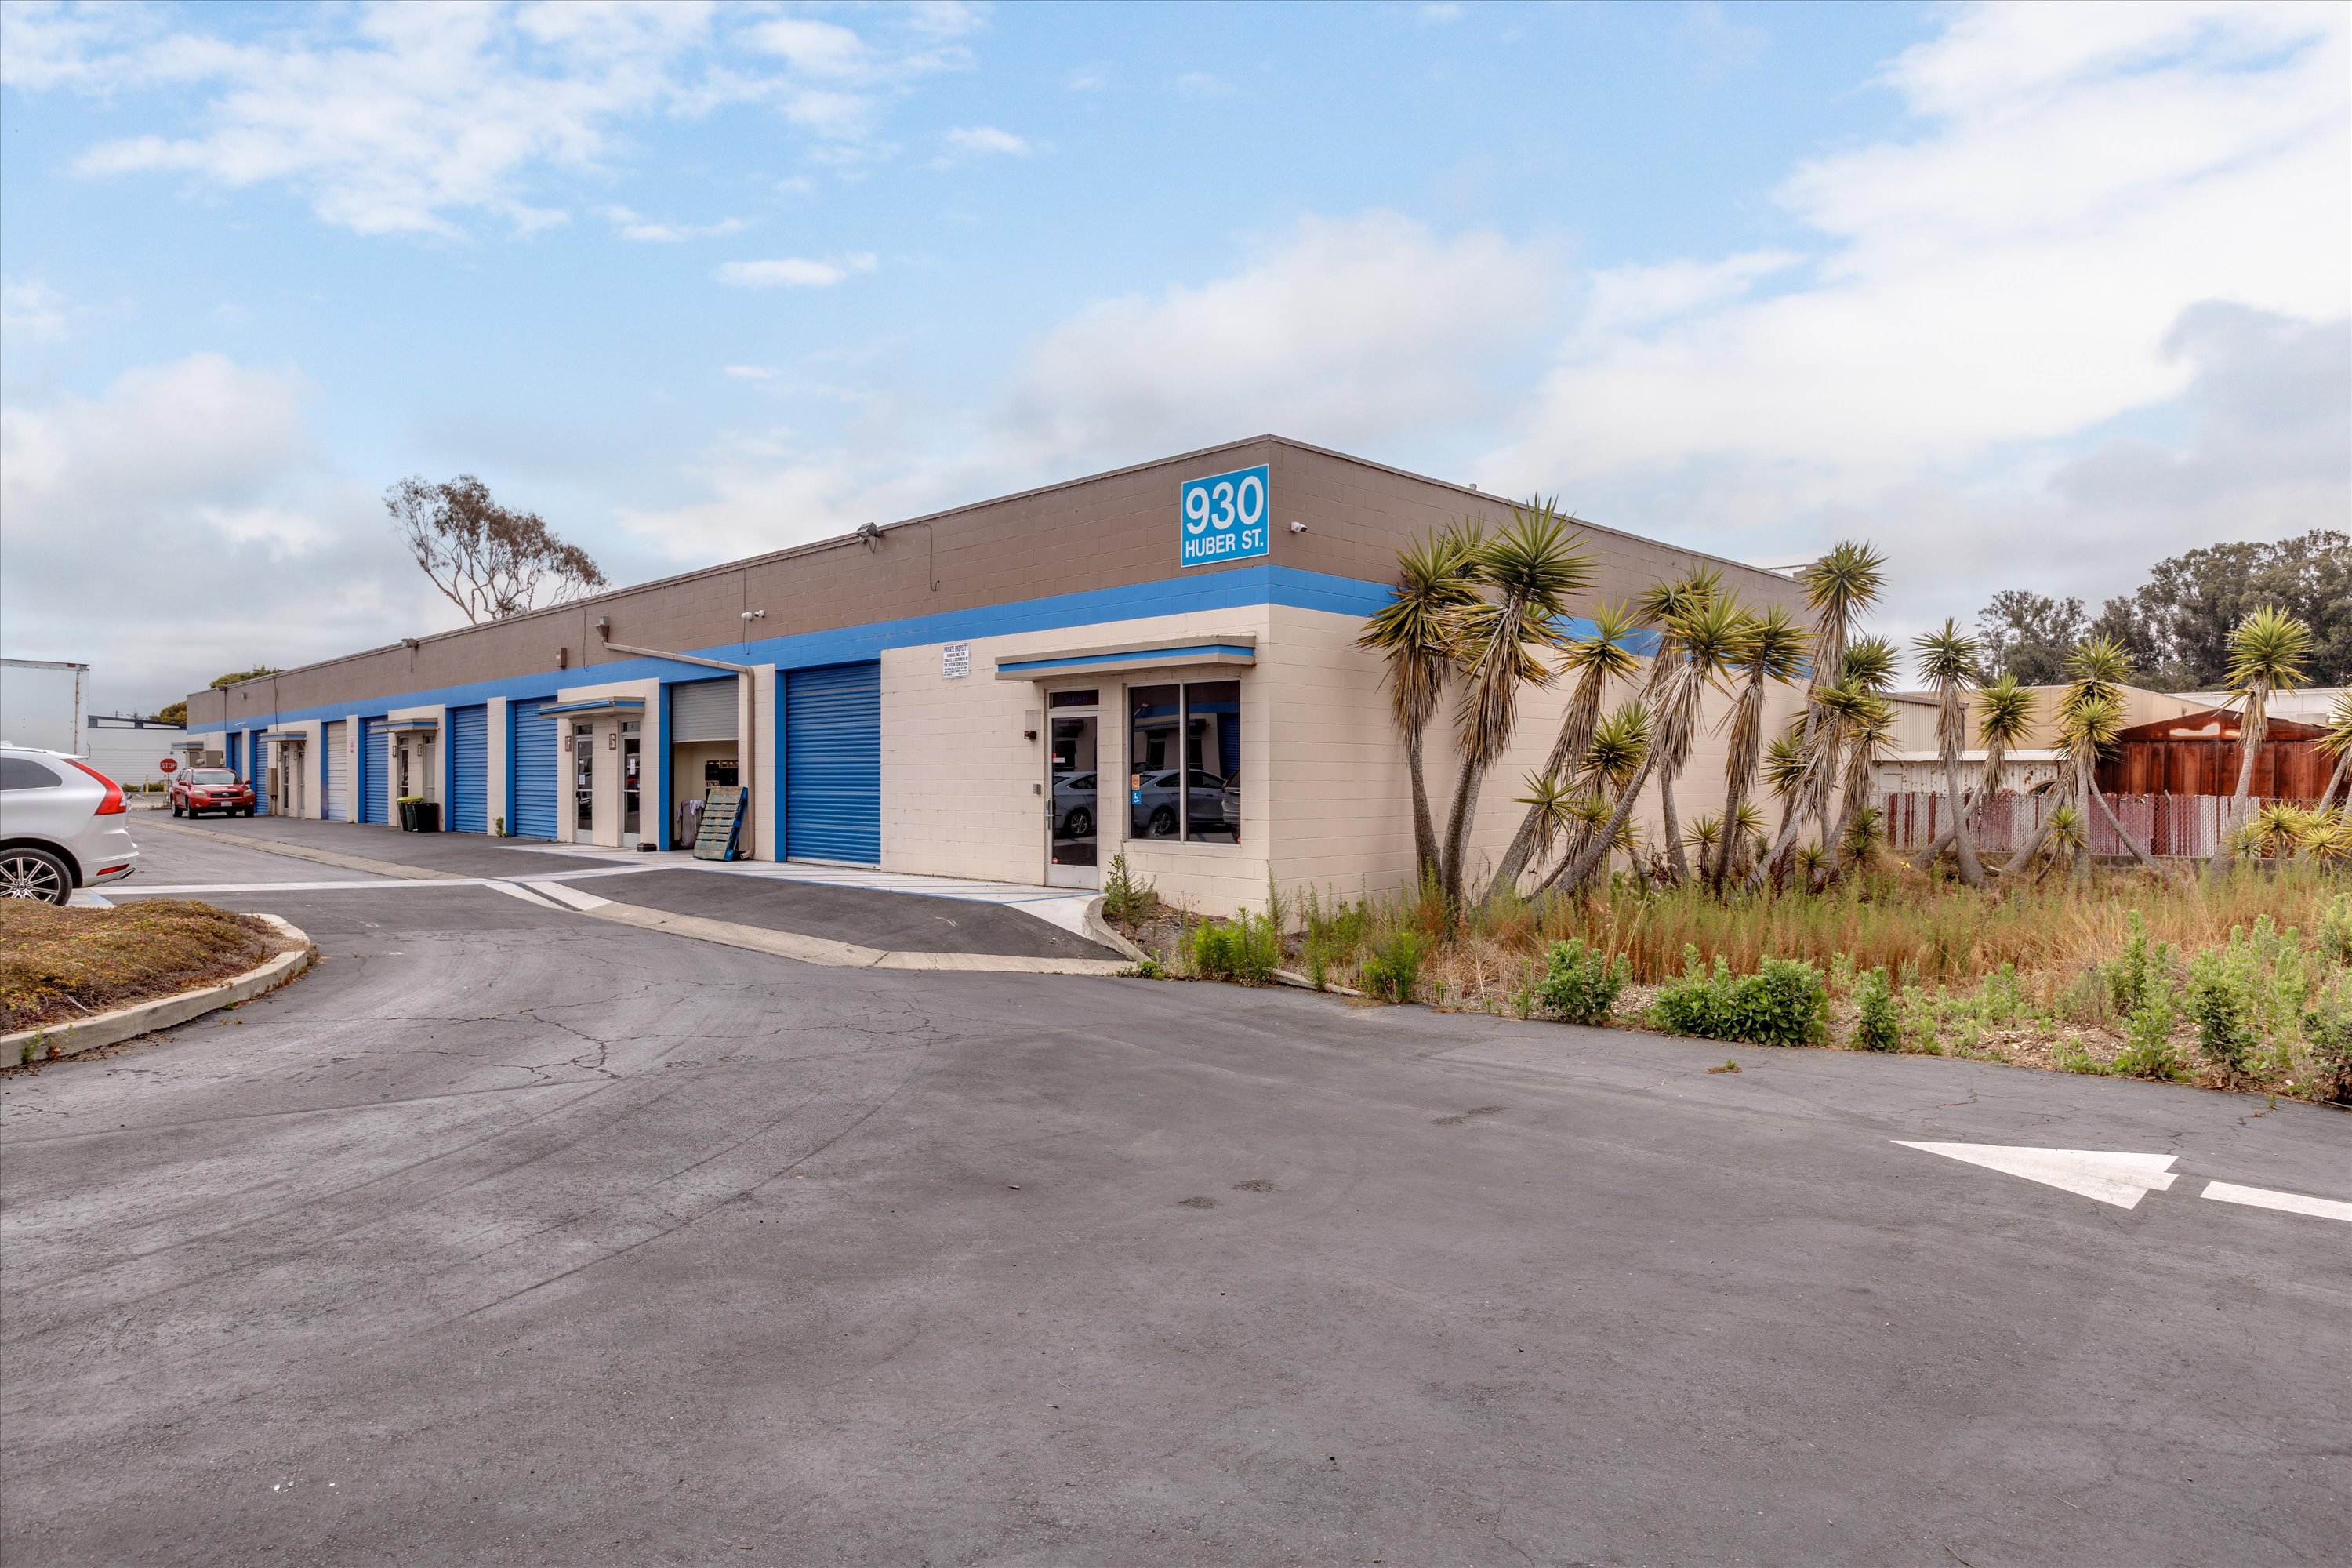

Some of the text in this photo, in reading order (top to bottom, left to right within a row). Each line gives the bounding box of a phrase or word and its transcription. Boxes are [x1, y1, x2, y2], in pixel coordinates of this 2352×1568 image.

[1186, 476, 1264, 535] 930
[1185, 528, 1264, 558] HUBER ST.
[1065, 694, 1088, 704] Suite H
[568, 737, 571, 750] F
